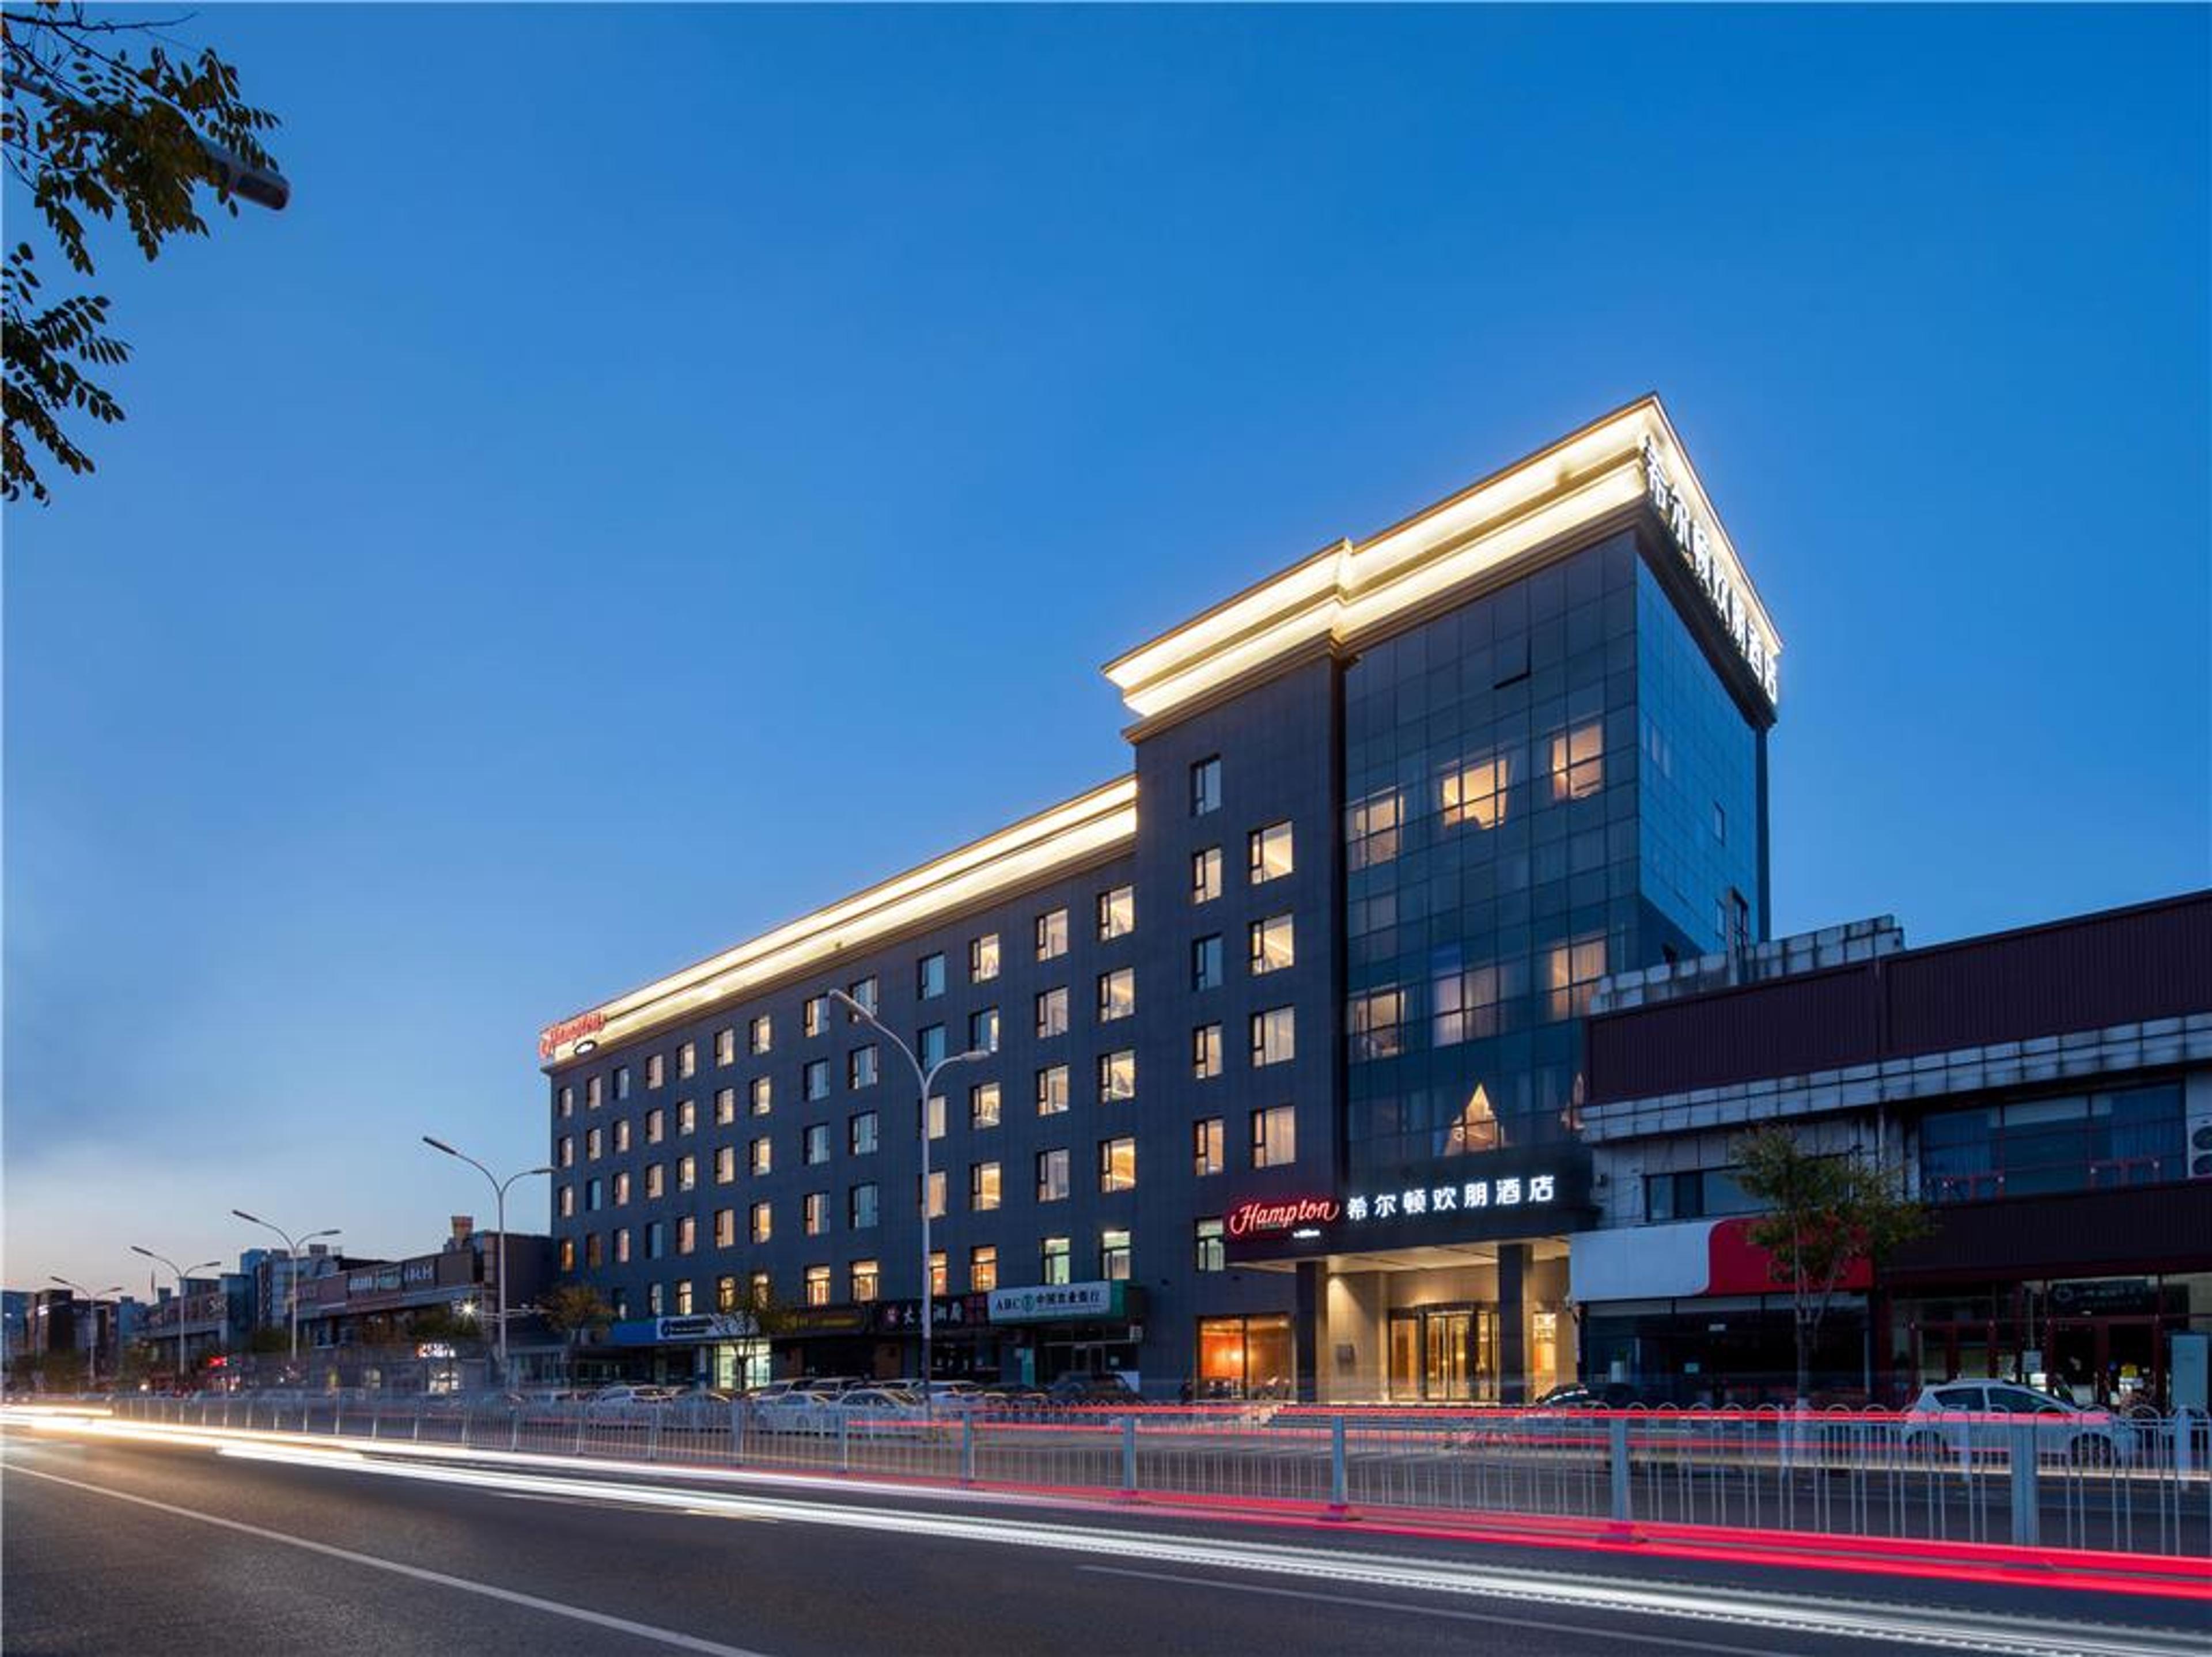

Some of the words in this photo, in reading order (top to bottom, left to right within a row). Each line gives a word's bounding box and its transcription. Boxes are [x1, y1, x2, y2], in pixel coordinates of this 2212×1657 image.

[1347, 1175, 1555, 1221] 希尔顿欢朋酒店
[1229, 1199, 1340, 1234] Hampton
[995, 1297, 1021, 1311] ABC
